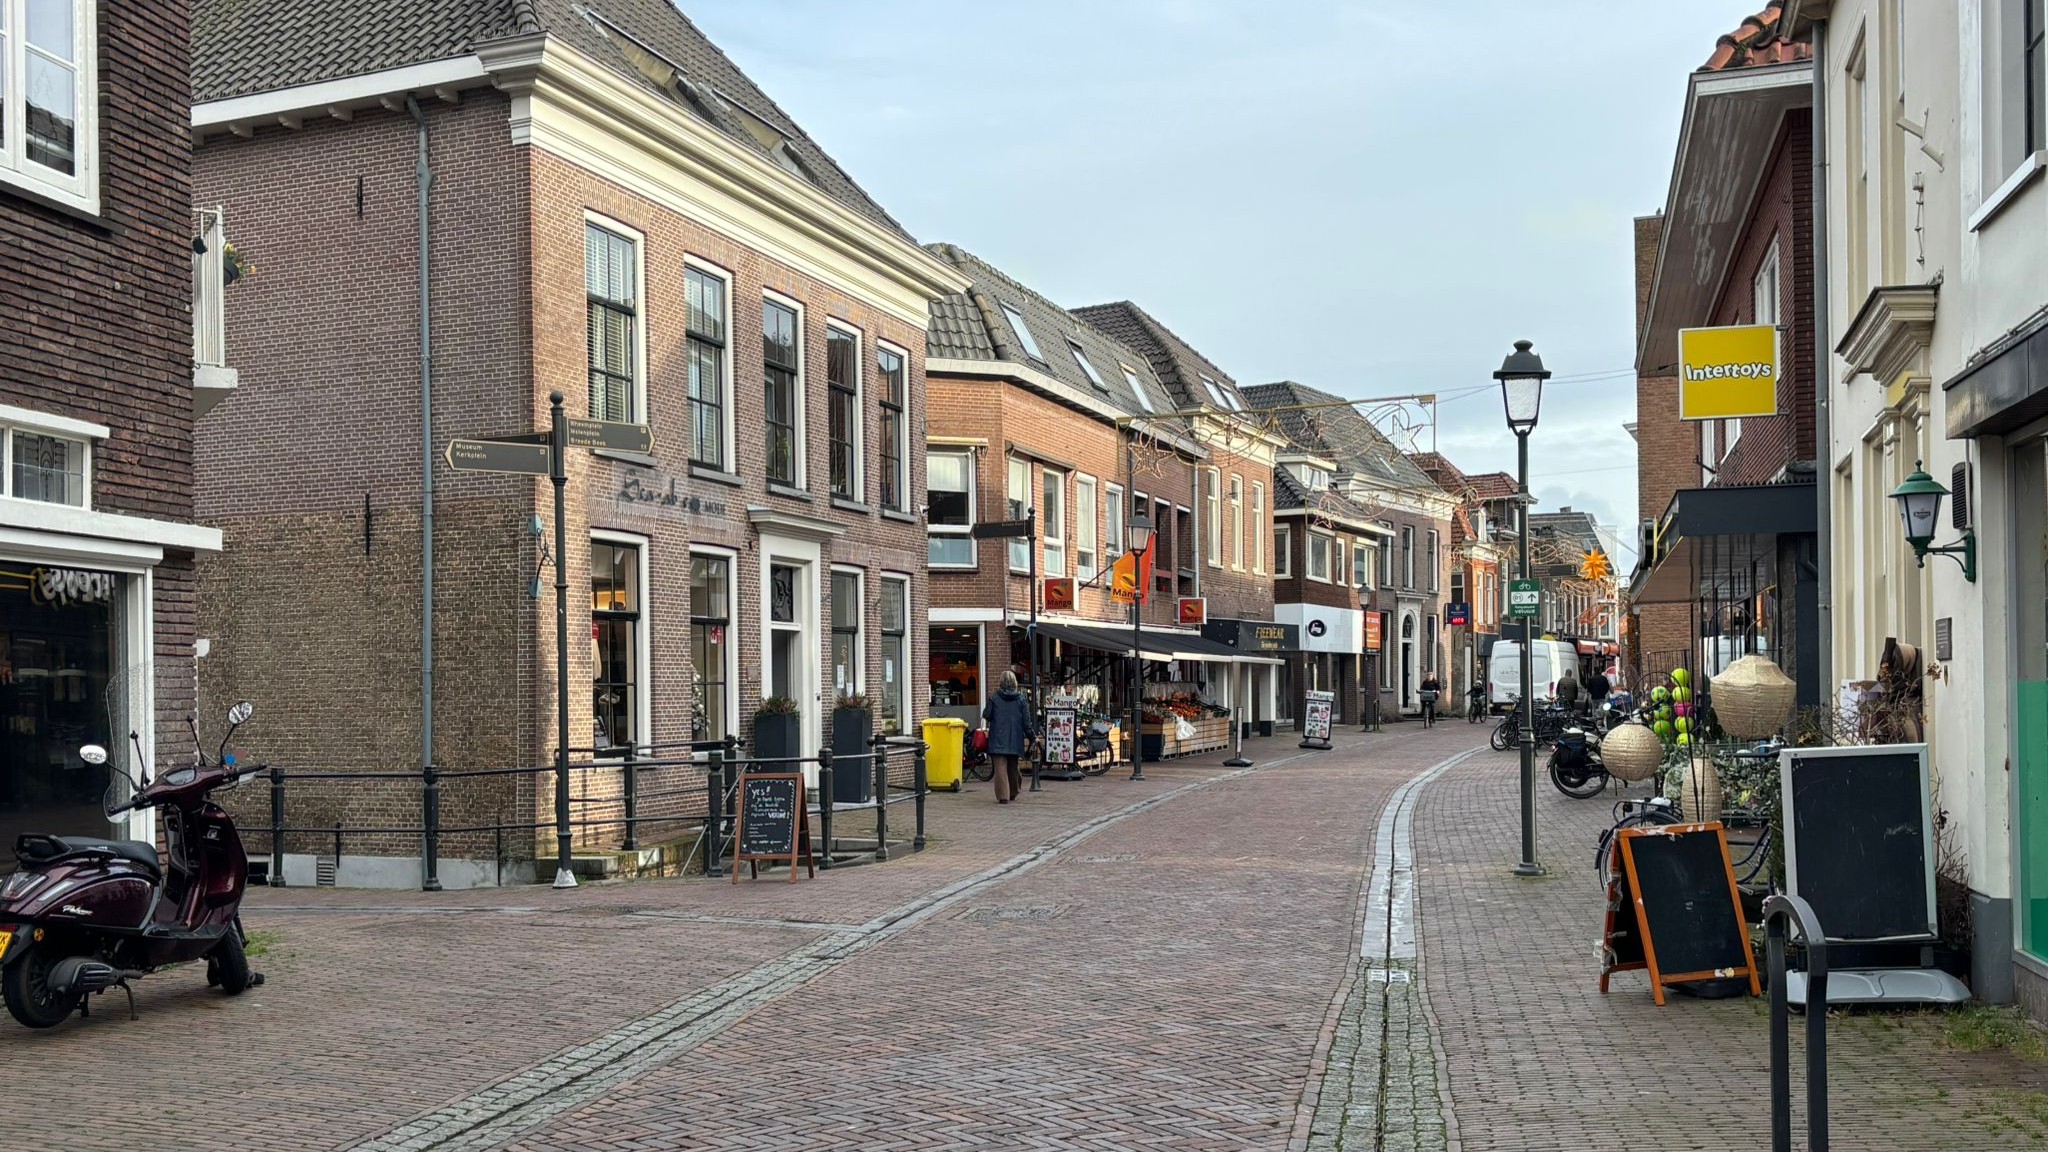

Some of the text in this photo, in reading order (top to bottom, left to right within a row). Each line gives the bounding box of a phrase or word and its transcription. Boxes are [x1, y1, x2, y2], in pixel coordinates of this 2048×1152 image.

[1685, 363, 1772, 381] Intertoys
[456, 443, 483, 451] Museum
[1047, 600, 1072, 608] Mango
[1053, 699, 1078, 708] Mango
